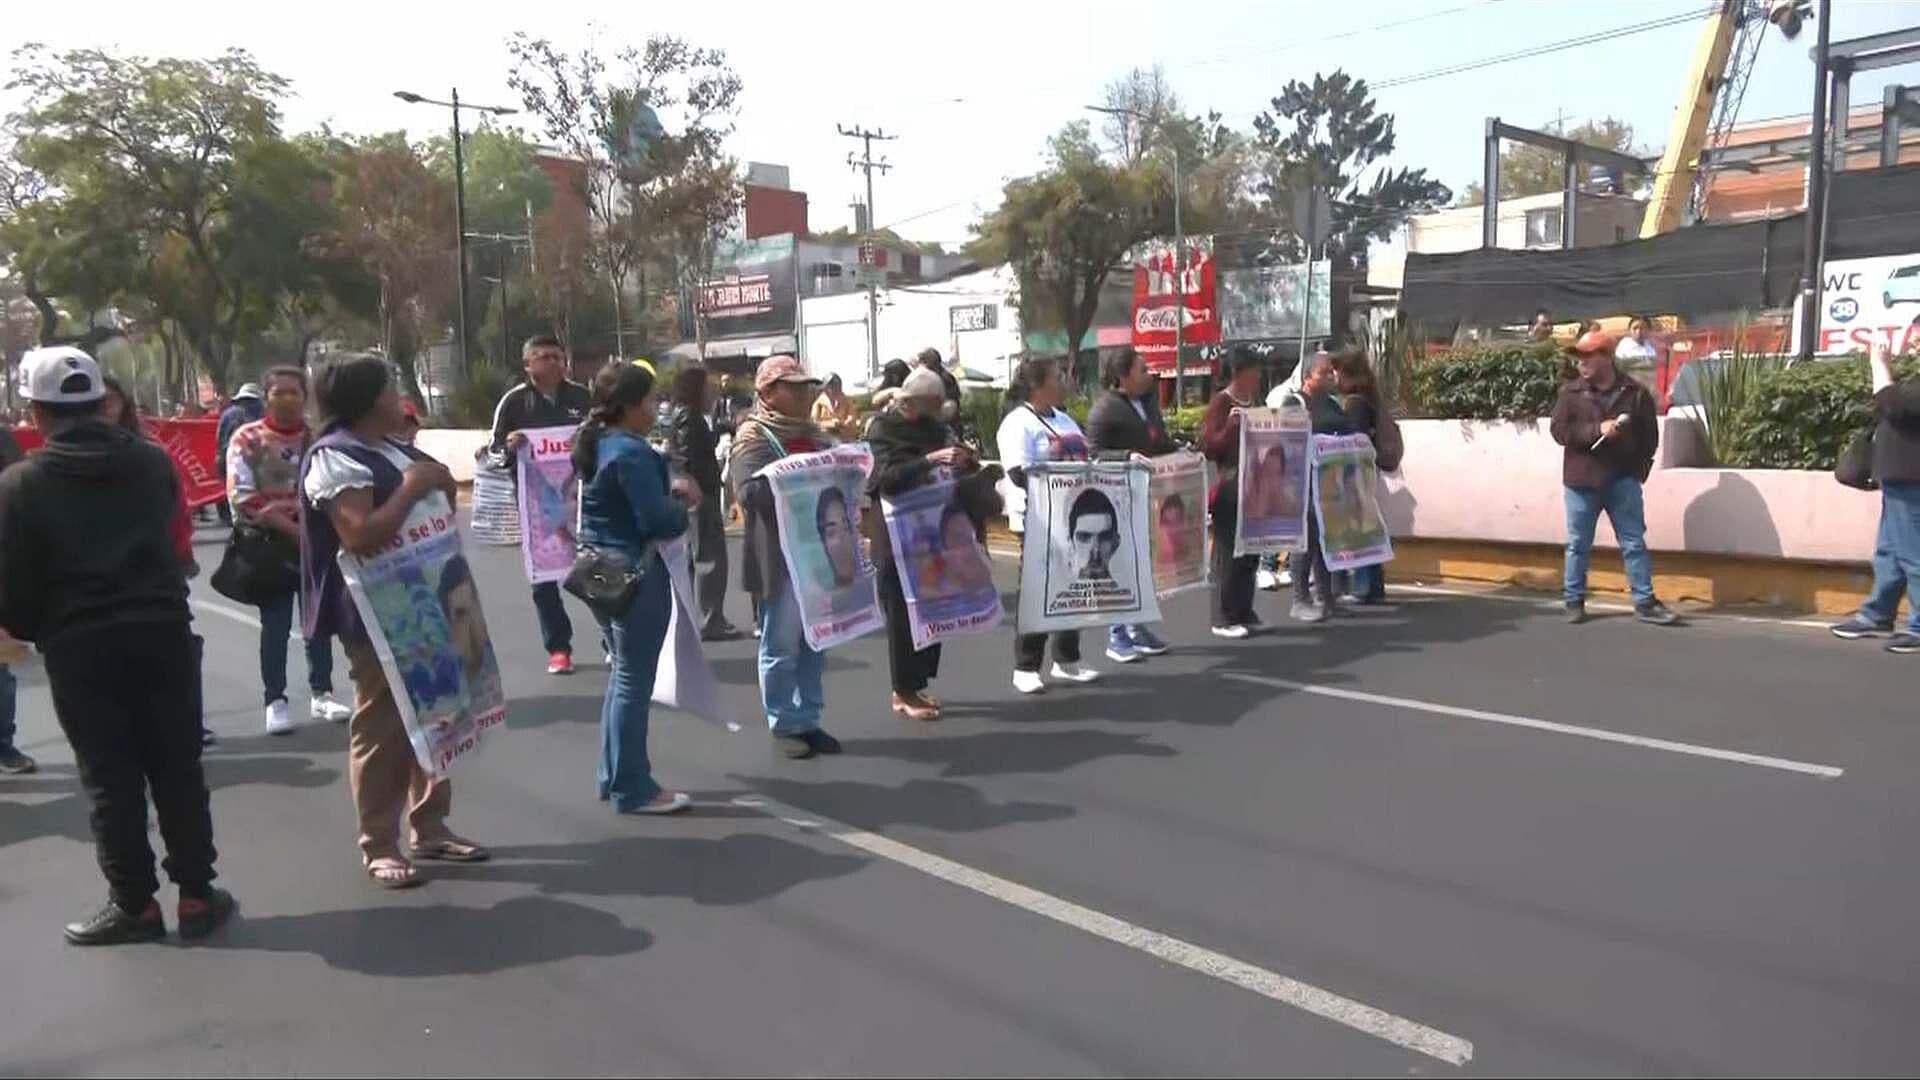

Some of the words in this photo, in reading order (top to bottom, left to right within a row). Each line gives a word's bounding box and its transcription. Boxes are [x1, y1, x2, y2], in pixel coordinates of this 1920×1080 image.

[1820, 272, 1862, 292] WC
[407, 527, 430, 543] se
[431, 516, 447, 532] lo
